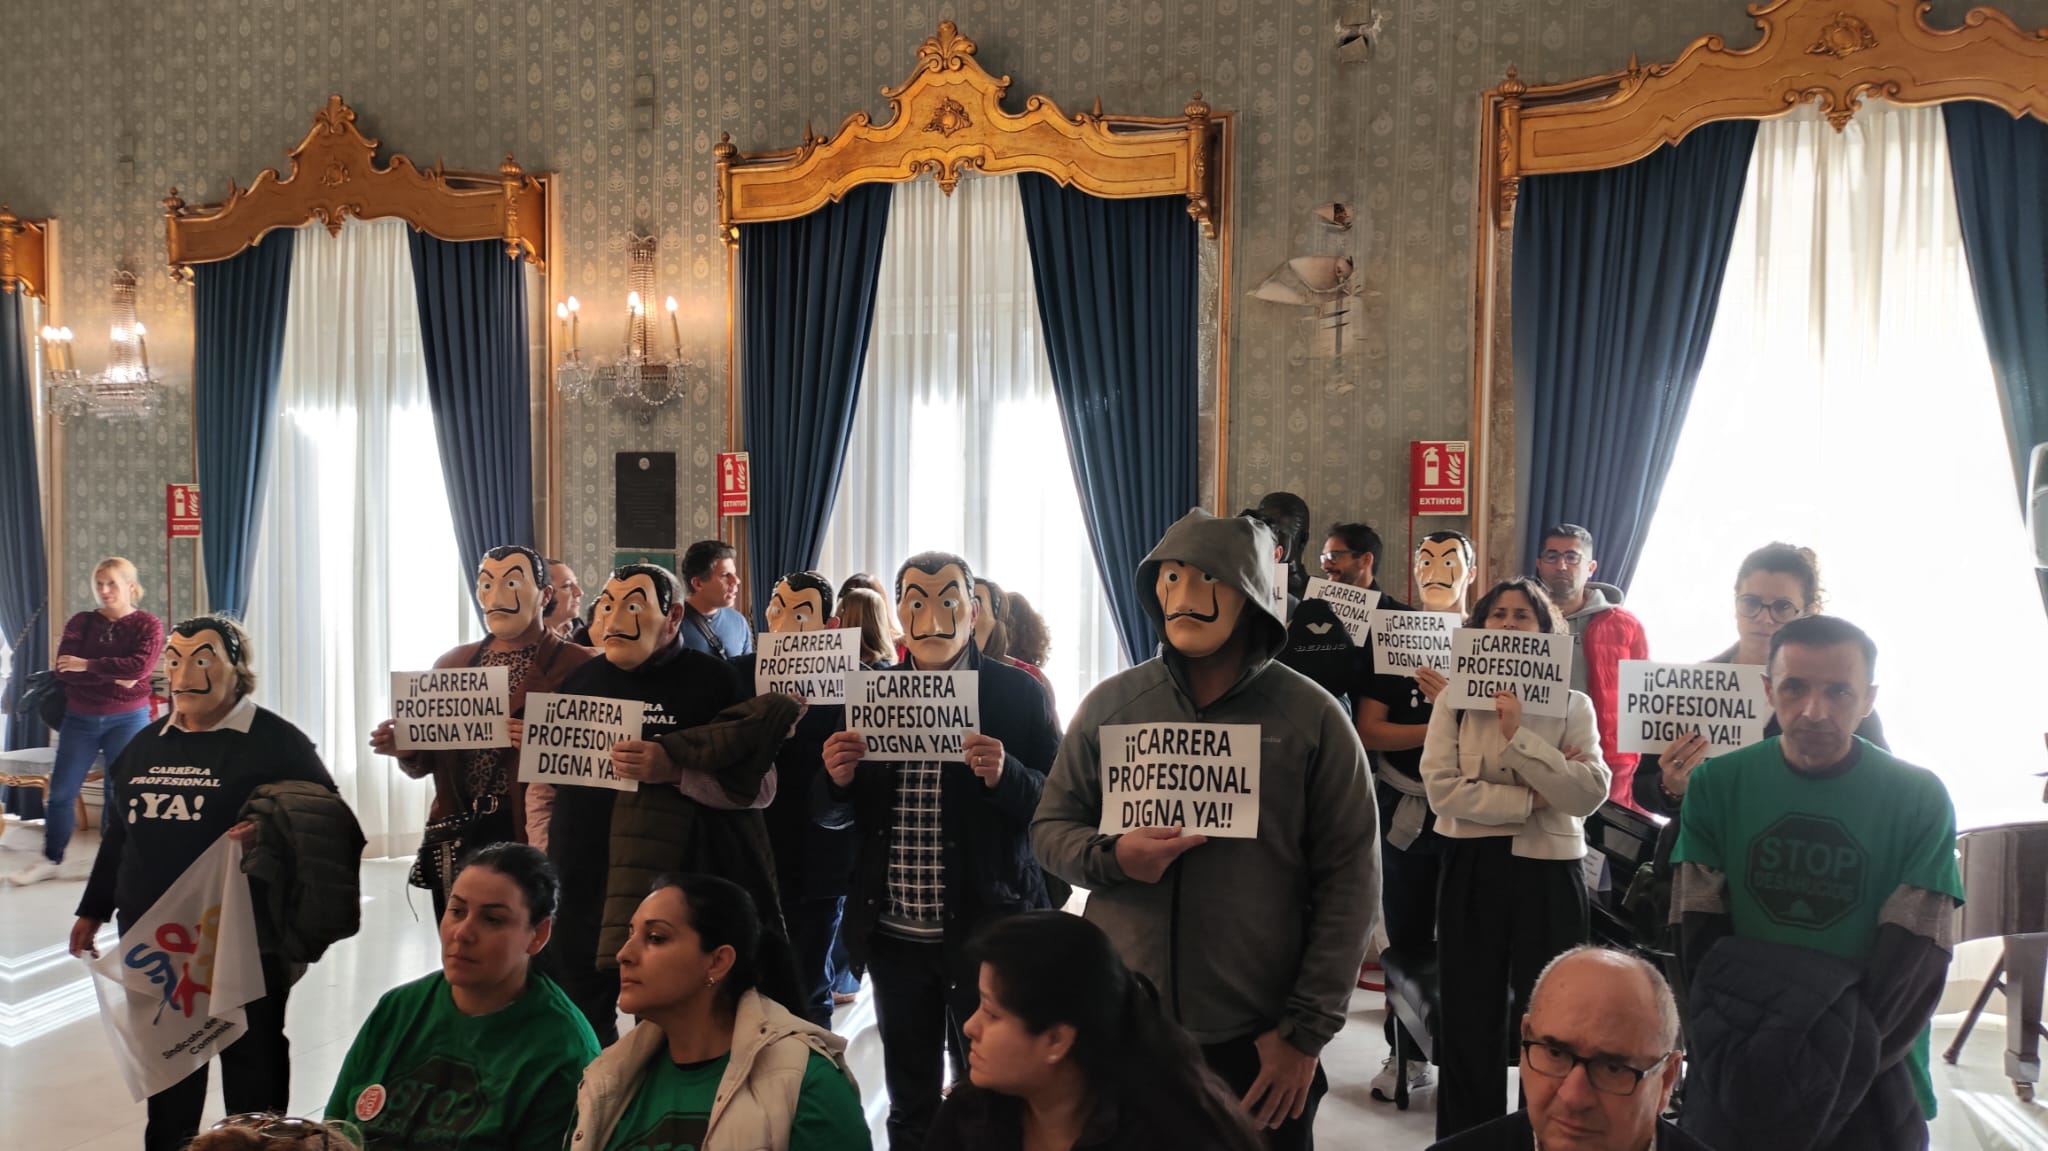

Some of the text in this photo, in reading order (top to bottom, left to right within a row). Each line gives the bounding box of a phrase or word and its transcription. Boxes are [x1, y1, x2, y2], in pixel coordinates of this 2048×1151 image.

[1420, 497, 1461, 505] EXTINTOR
[1331, 601, 1370, 623] SIONAL
[1385, 615, 1446, 632] ¡¡CARRERA
[773, 633, 843, 656] ¡¡CARRERA
[1377, 632, 1452, 650] PROFESIONA
[1472, 634, 1551, 657] ¡¡CARRERA
[759, 655, 854, 675] PROFESIONAL
[1388, 651, 1450, 670] DIGNA YA!!
[1457, 656, 1564, 682] PROFESIONAL
[409, 672, 489, 697] ¡¡CARRERA
[769, 679, 844, 698] DIGNA YA!!
[866, 675, 956, 703] ¡¡CARRERA
[1643, 667, 1740, 692] ¡¡CARRERA
[1523, 683, 1550, 704] YA!!
[395, 697, 504, 718] PROFESIONAL
[545, 698, 623, 726] ¡¡CARRERA
[851, 705, 974, 728] PROFESIONAL
[1627, 693, 1757, 719] PROFESIONAL
[409, 722, 493, 742] DIGNA YA!!
[527, 724, 632, 752] PROFESION
[865, 734, 963, 753] DIGNA YA!!
[1708, 724, 1741, 746] YA!!
[1125, 728, 1232, 763] ¡¡CARRERA
[148, 766, 211, 776] CARRERA
[538, 752, 622, 781] DIGNA YA
[128, 776, 221, 788] PROFESIONAL
[1109, 763, 1251, 794] PROFESIONAL
[127, 792, 205, 824] ¡YA!
[1122, 799, 1233, 828] DIGNA YA!!
[1760, 836, 1858, 879] STOP
